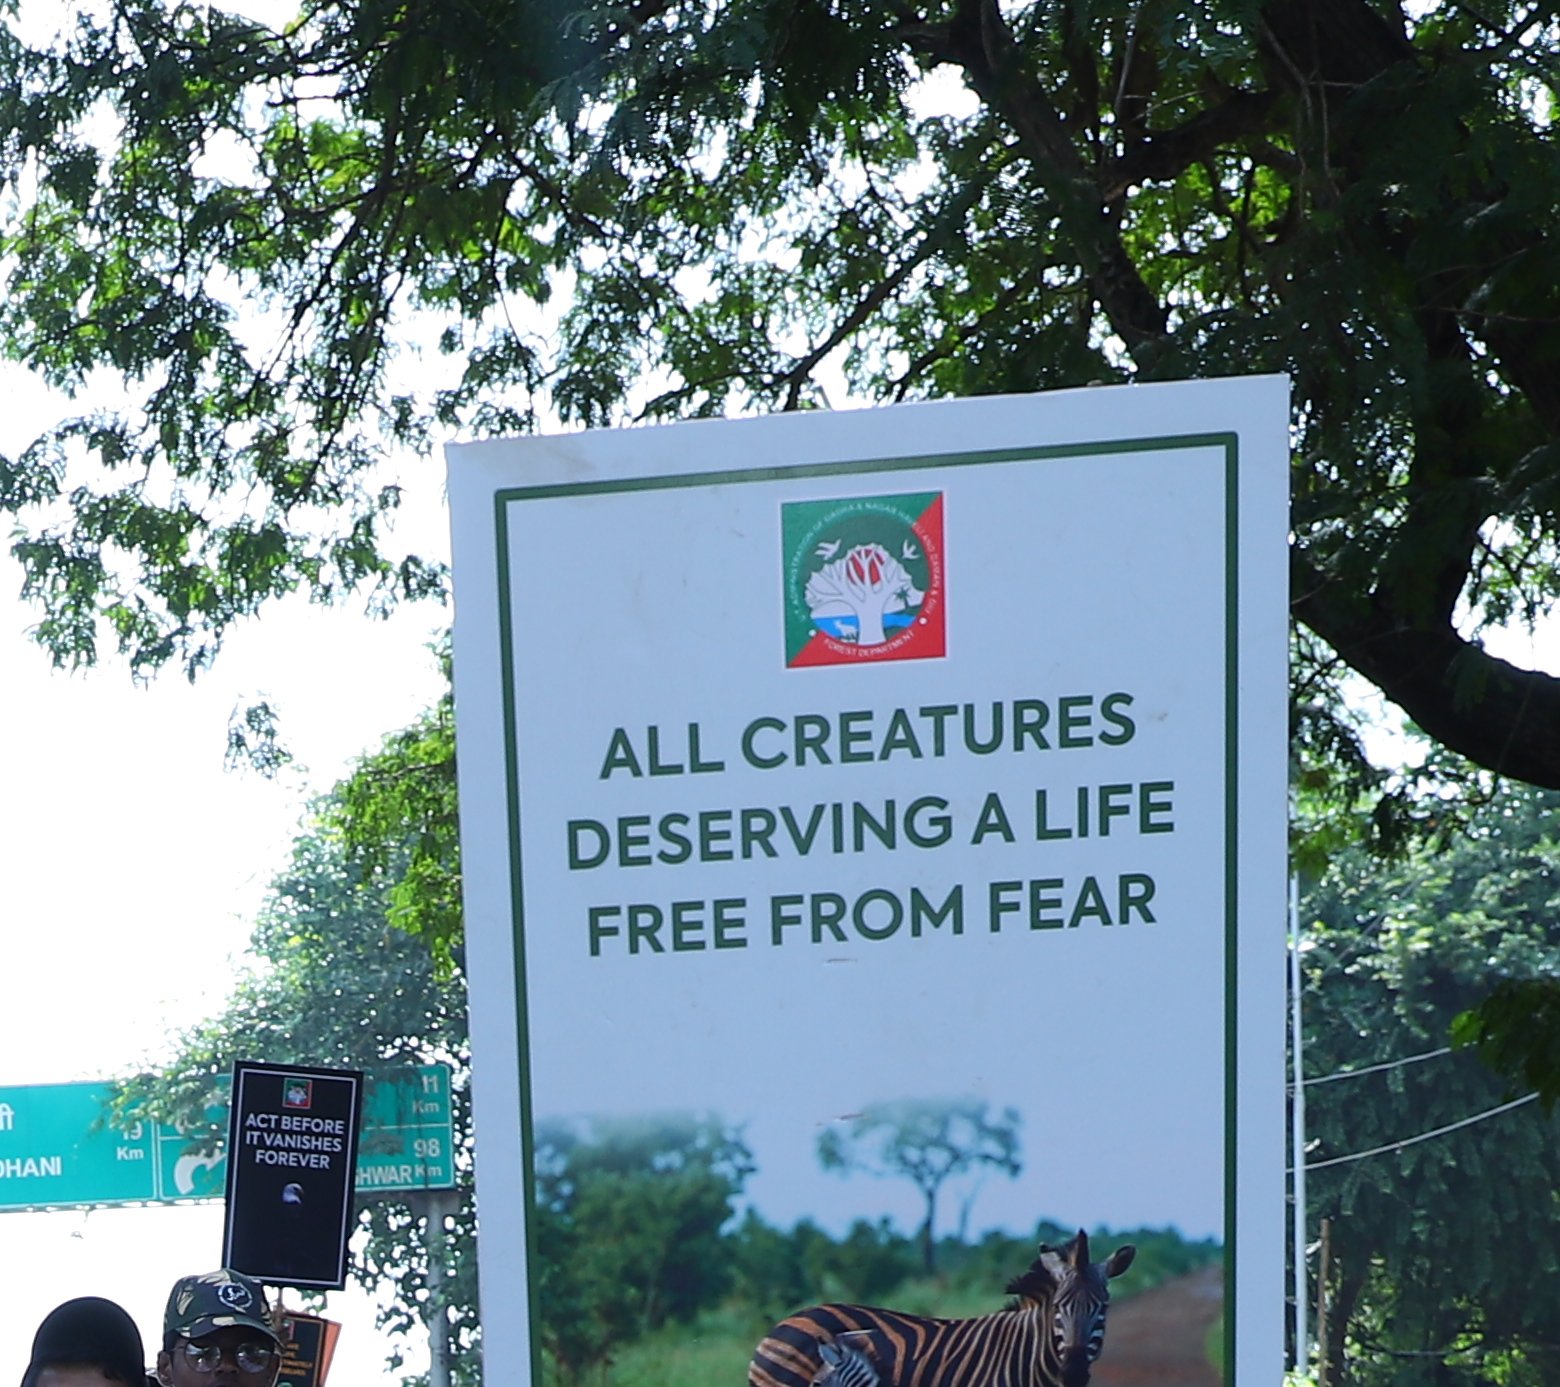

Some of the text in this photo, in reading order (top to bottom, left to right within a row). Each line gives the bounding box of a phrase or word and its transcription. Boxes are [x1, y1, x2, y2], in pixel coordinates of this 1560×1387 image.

[598, 691, 1136, 780] ALL CREATURES
[566, 780, 1175, 871] DESERVING A LIFE
[587, 872, 1158, 958] FREE FROM FEAR
[422, 1075, 439, 1094] 11
[413, 1100, 439, 1113] Km
[120, 1121, 144, 1140] 19
[245, 1113, 345, 1135] ACT BEFORE
[246, 1131, 343, 1153] IT VANISHES
[414, 1138, 441, 1158] 98
[116, 1146, 144, 1160] Km
[255, 1150, 330, 1169] FOREVER
[414, 1164, 442, 1177] Km
